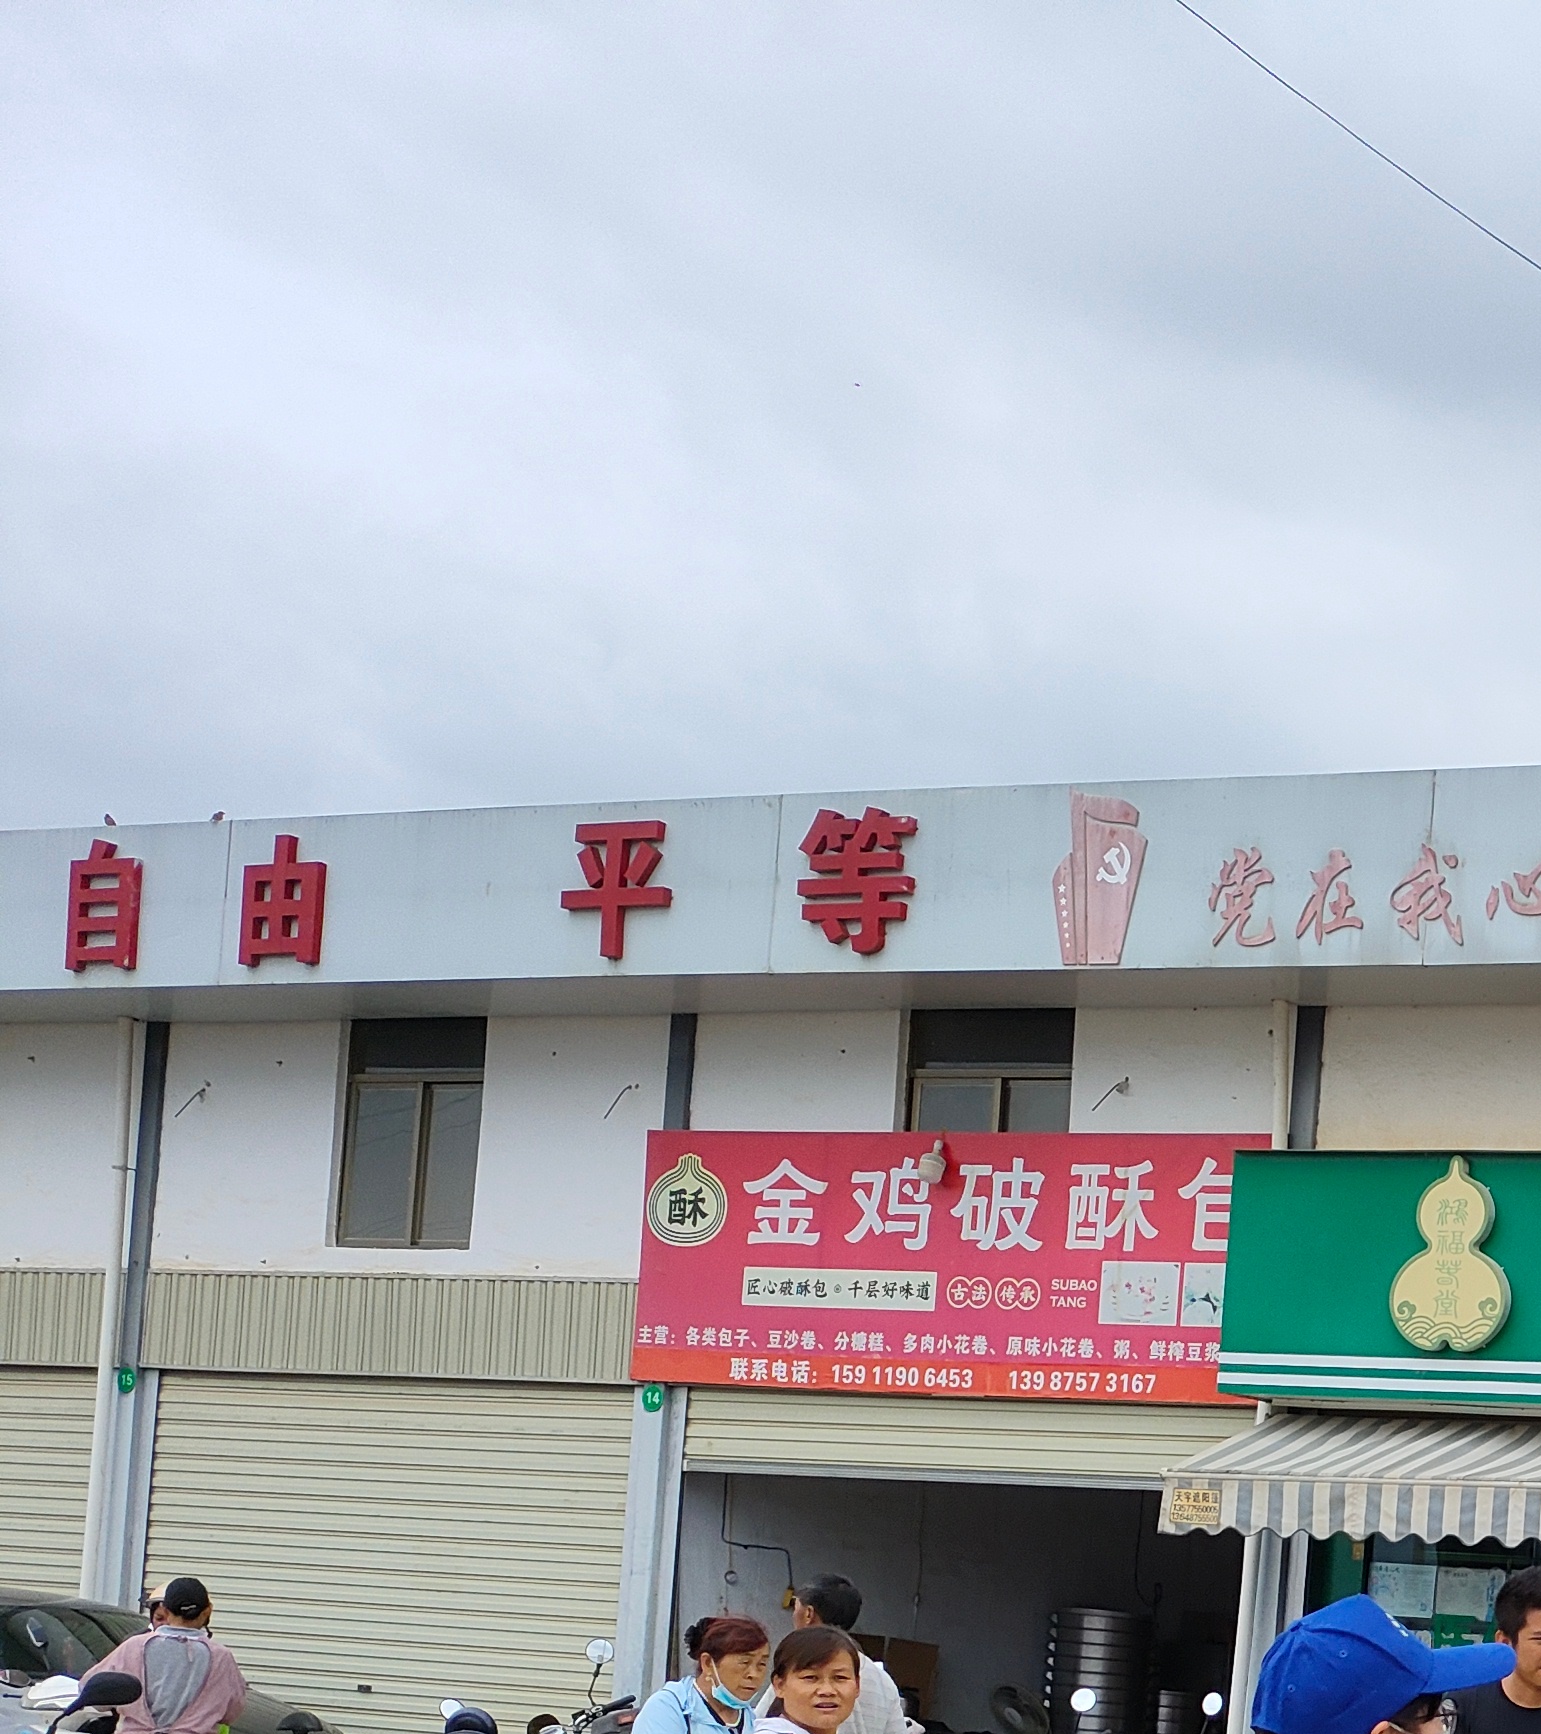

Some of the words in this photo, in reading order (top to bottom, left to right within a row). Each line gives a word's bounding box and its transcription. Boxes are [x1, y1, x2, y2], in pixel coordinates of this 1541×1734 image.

[667, 1186, 710, 1228] 酥
[847, 1280, 932, 1301] 千层好味道
[1051, 1278, 1098, 1292] SUBAO
[1050, 1296, 1087, 1309] TANG
[120, 1372, 135, 1388] 15
[831, 1365, 866, 1384] 159
[872, 1366, 919, 1387] 1190
[924, 1368, 973, 1389] 6453
[1008, 1370, 1044, 1391] 139
[1050, 1371, 1100, 1393] 8757
[1105, 1373, 1157, 1394] 3167
[646, 1391, 660, 1405] 14
